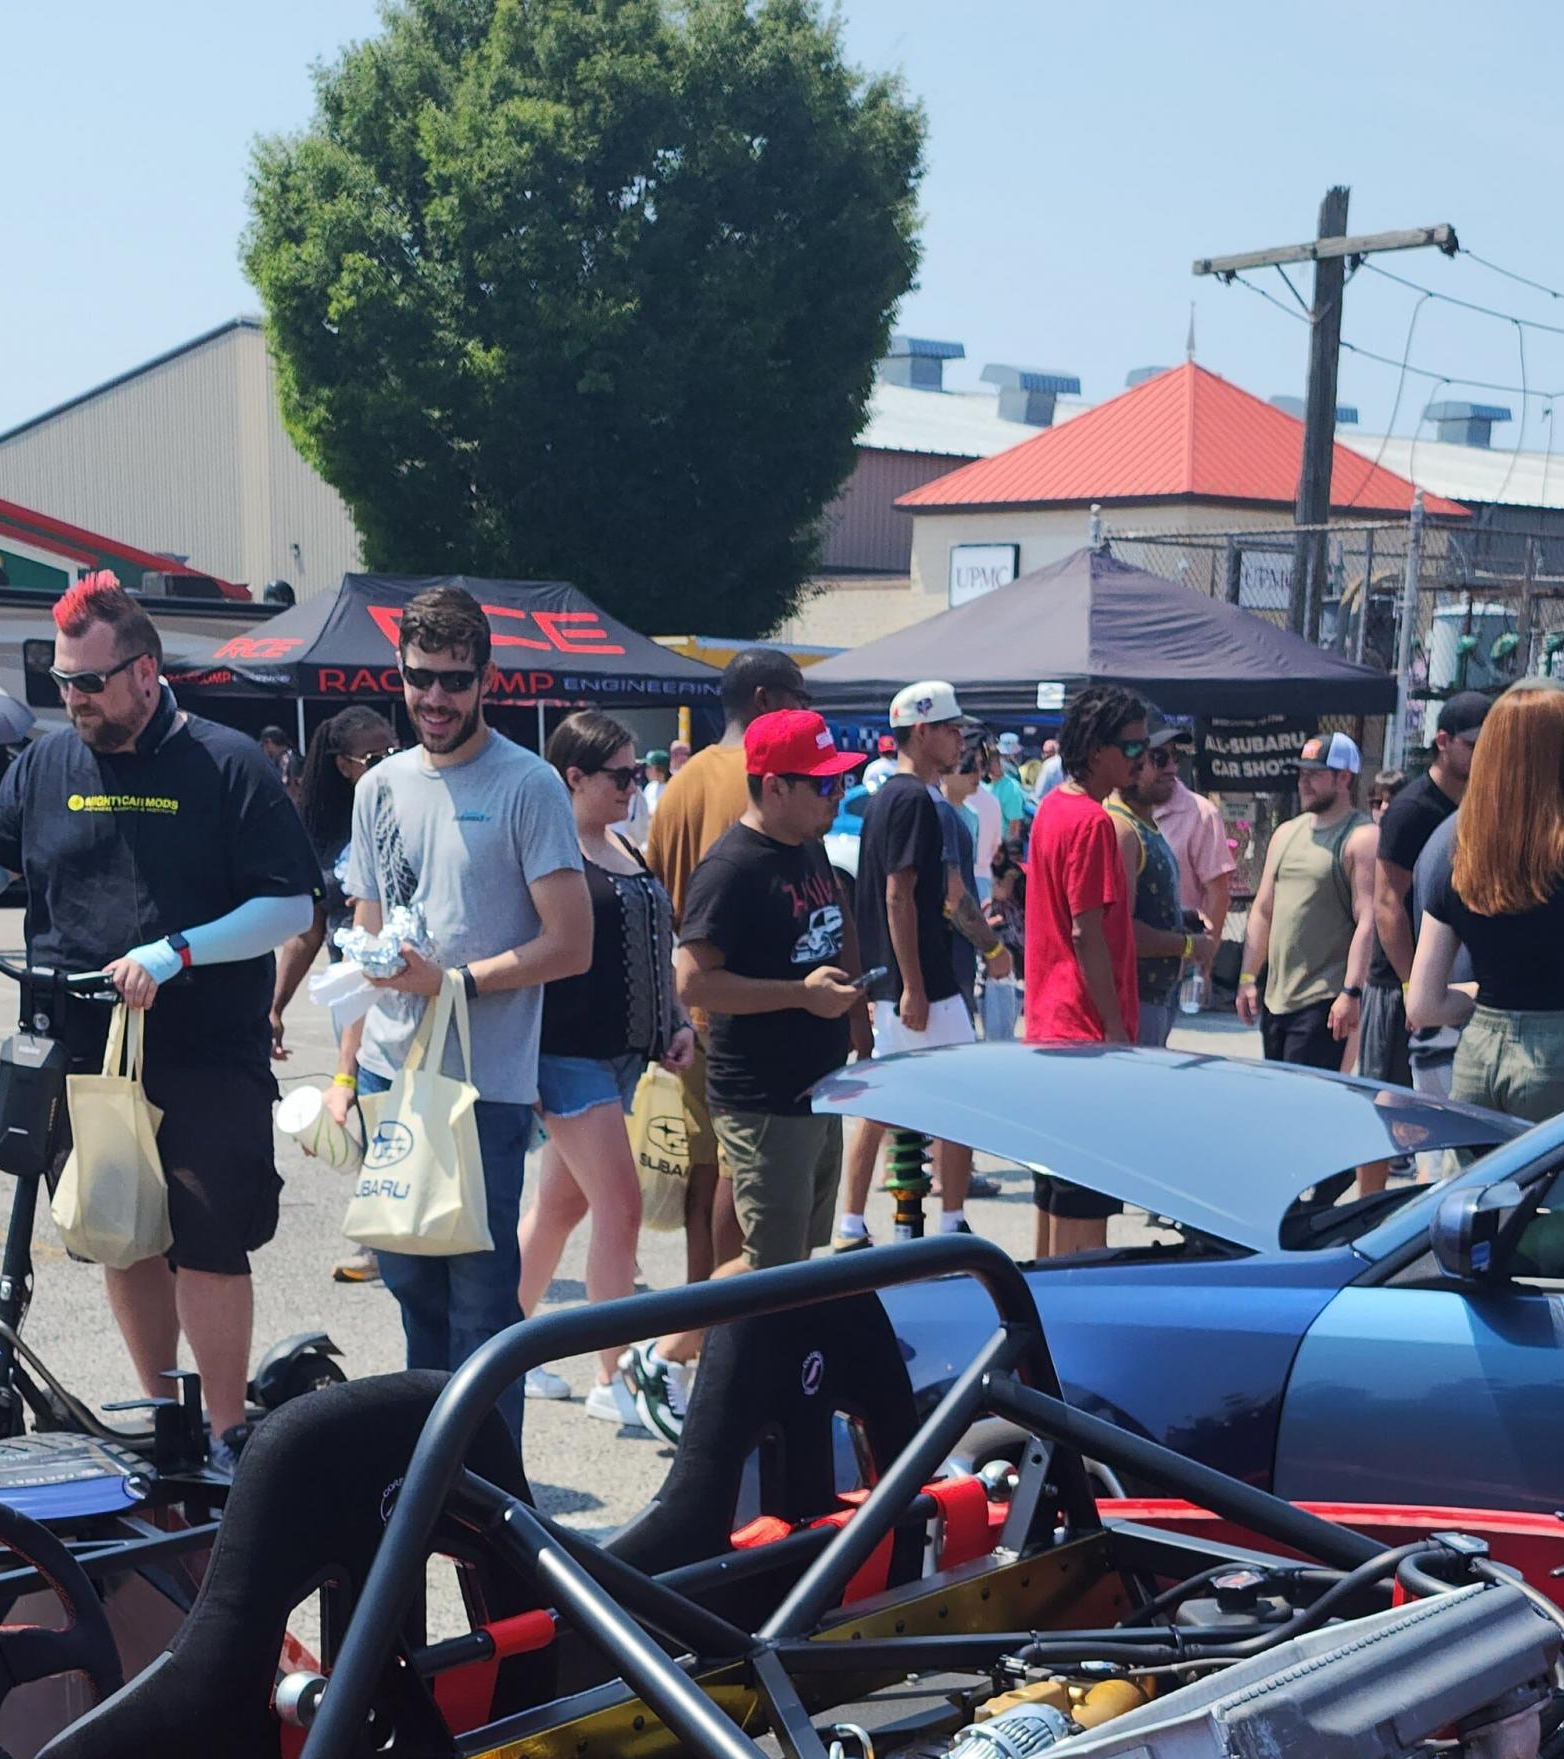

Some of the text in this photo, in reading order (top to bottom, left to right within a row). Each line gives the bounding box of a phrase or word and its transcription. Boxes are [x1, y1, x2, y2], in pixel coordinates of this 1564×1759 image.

[956, 565, 1009, 589] UPMC
[563, 676, 722, 697] ENGINEERIN
[1211, 758, 1241, 778] CAR
[145, 797, 179, 810] MODS
[355, 1179, 411, 1199] BARU
